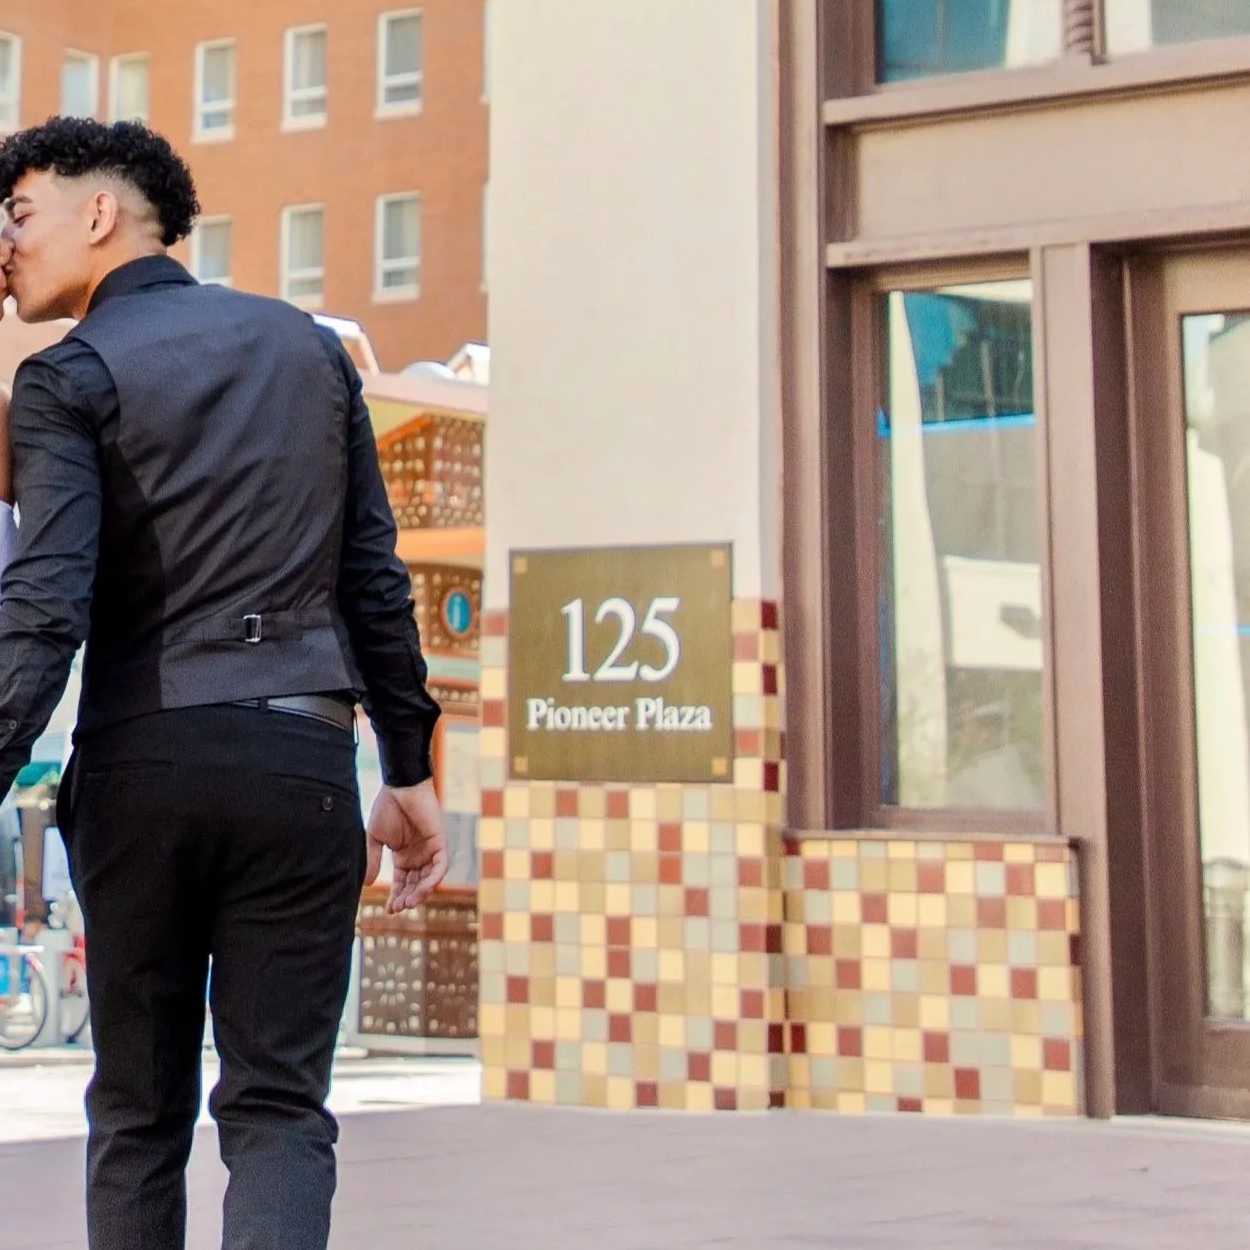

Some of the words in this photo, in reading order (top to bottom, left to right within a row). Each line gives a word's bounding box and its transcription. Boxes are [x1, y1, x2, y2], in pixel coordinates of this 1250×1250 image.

[561, 597, 681, 682] 125
[526, 697, 630, 731] Pioneer
[635, 696, 713, 731] Plaza
